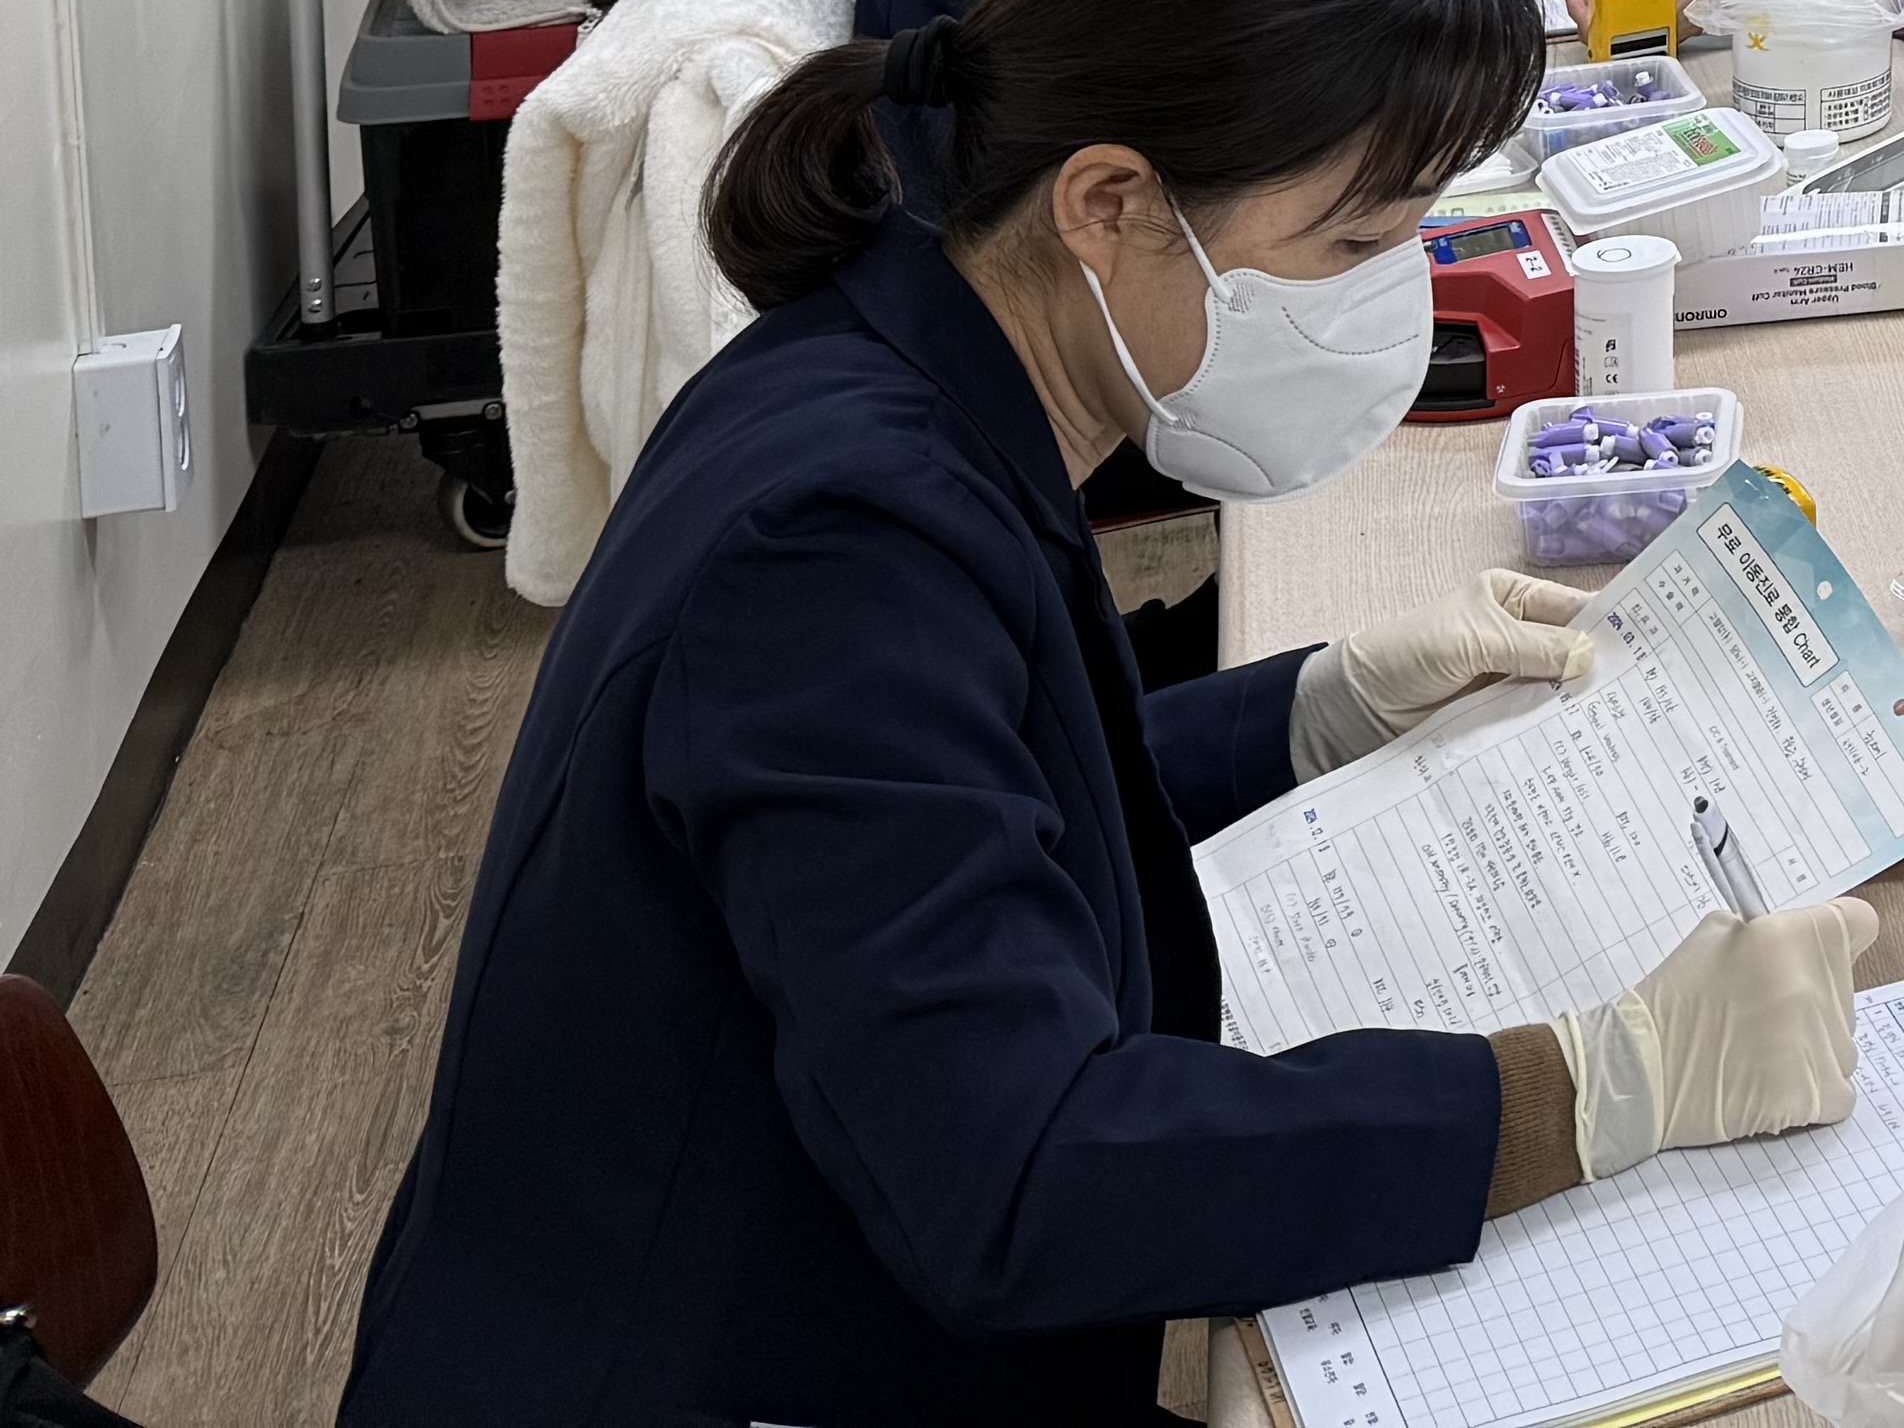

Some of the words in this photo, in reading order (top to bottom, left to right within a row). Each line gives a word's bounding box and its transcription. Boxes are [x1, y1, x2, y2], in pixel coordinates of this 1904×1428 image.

[1809, 283, 1850, 295] Pressure
[1852, 281, 1877, 291] Blood
[1773, 287, 1807, 299] Monitor
[1675, 308, 1728, 323] OMRON
[1714, 523, 1744, 554] 무료
[1735, 551, 1784, 607] 이동진료
[1771, 605, 1801, 633] 통합
[1788, 631, 1825, 668] Chart
